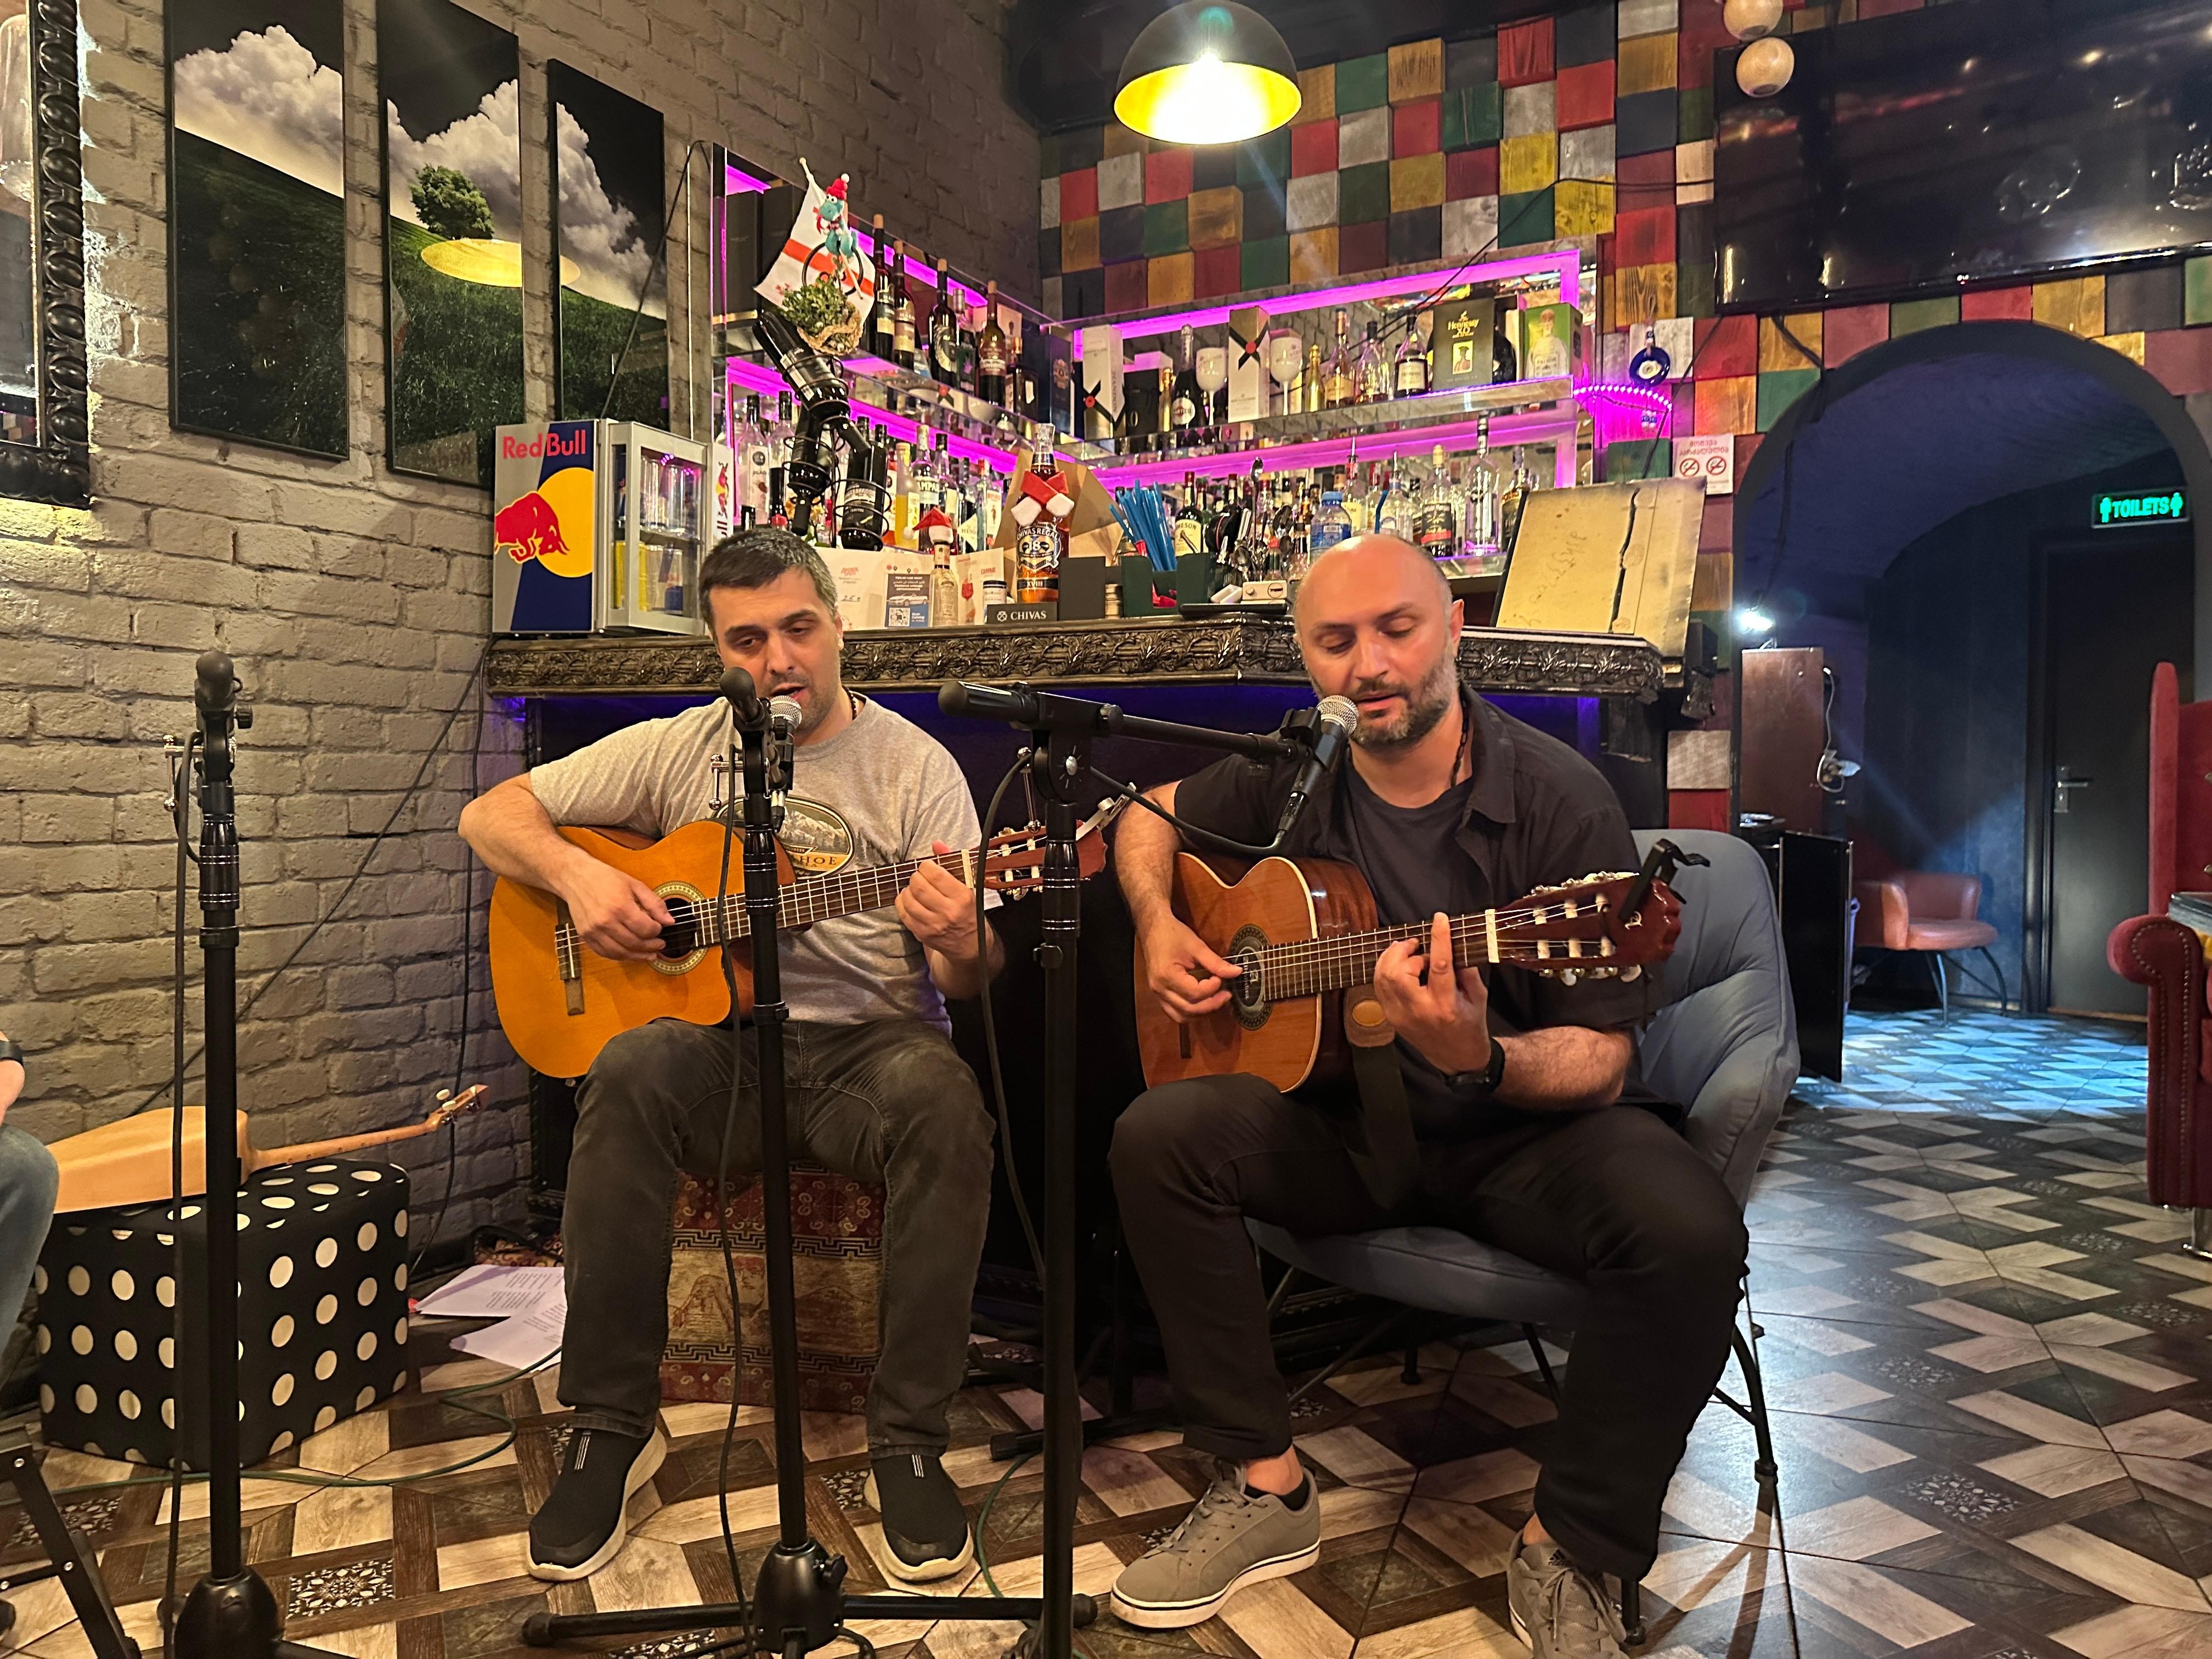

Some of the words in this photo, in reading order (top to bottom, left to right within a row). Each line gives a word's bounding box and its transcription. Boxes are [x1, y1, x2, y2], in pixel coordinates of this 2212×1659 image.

[503, 432, 543, 459] Red
[546, 429, 586, 457] Bull
[2112, 496, 2170, 518] TOILETS
[1017, 528, 1036, 541] CHIVAS
[1036, 528, 1058, 540] REGAL
[1029, 540, 1041, 551] 18
[1010, 610, 1047, 620] CHIVAS
[799, 856, 837, 865] HOE
